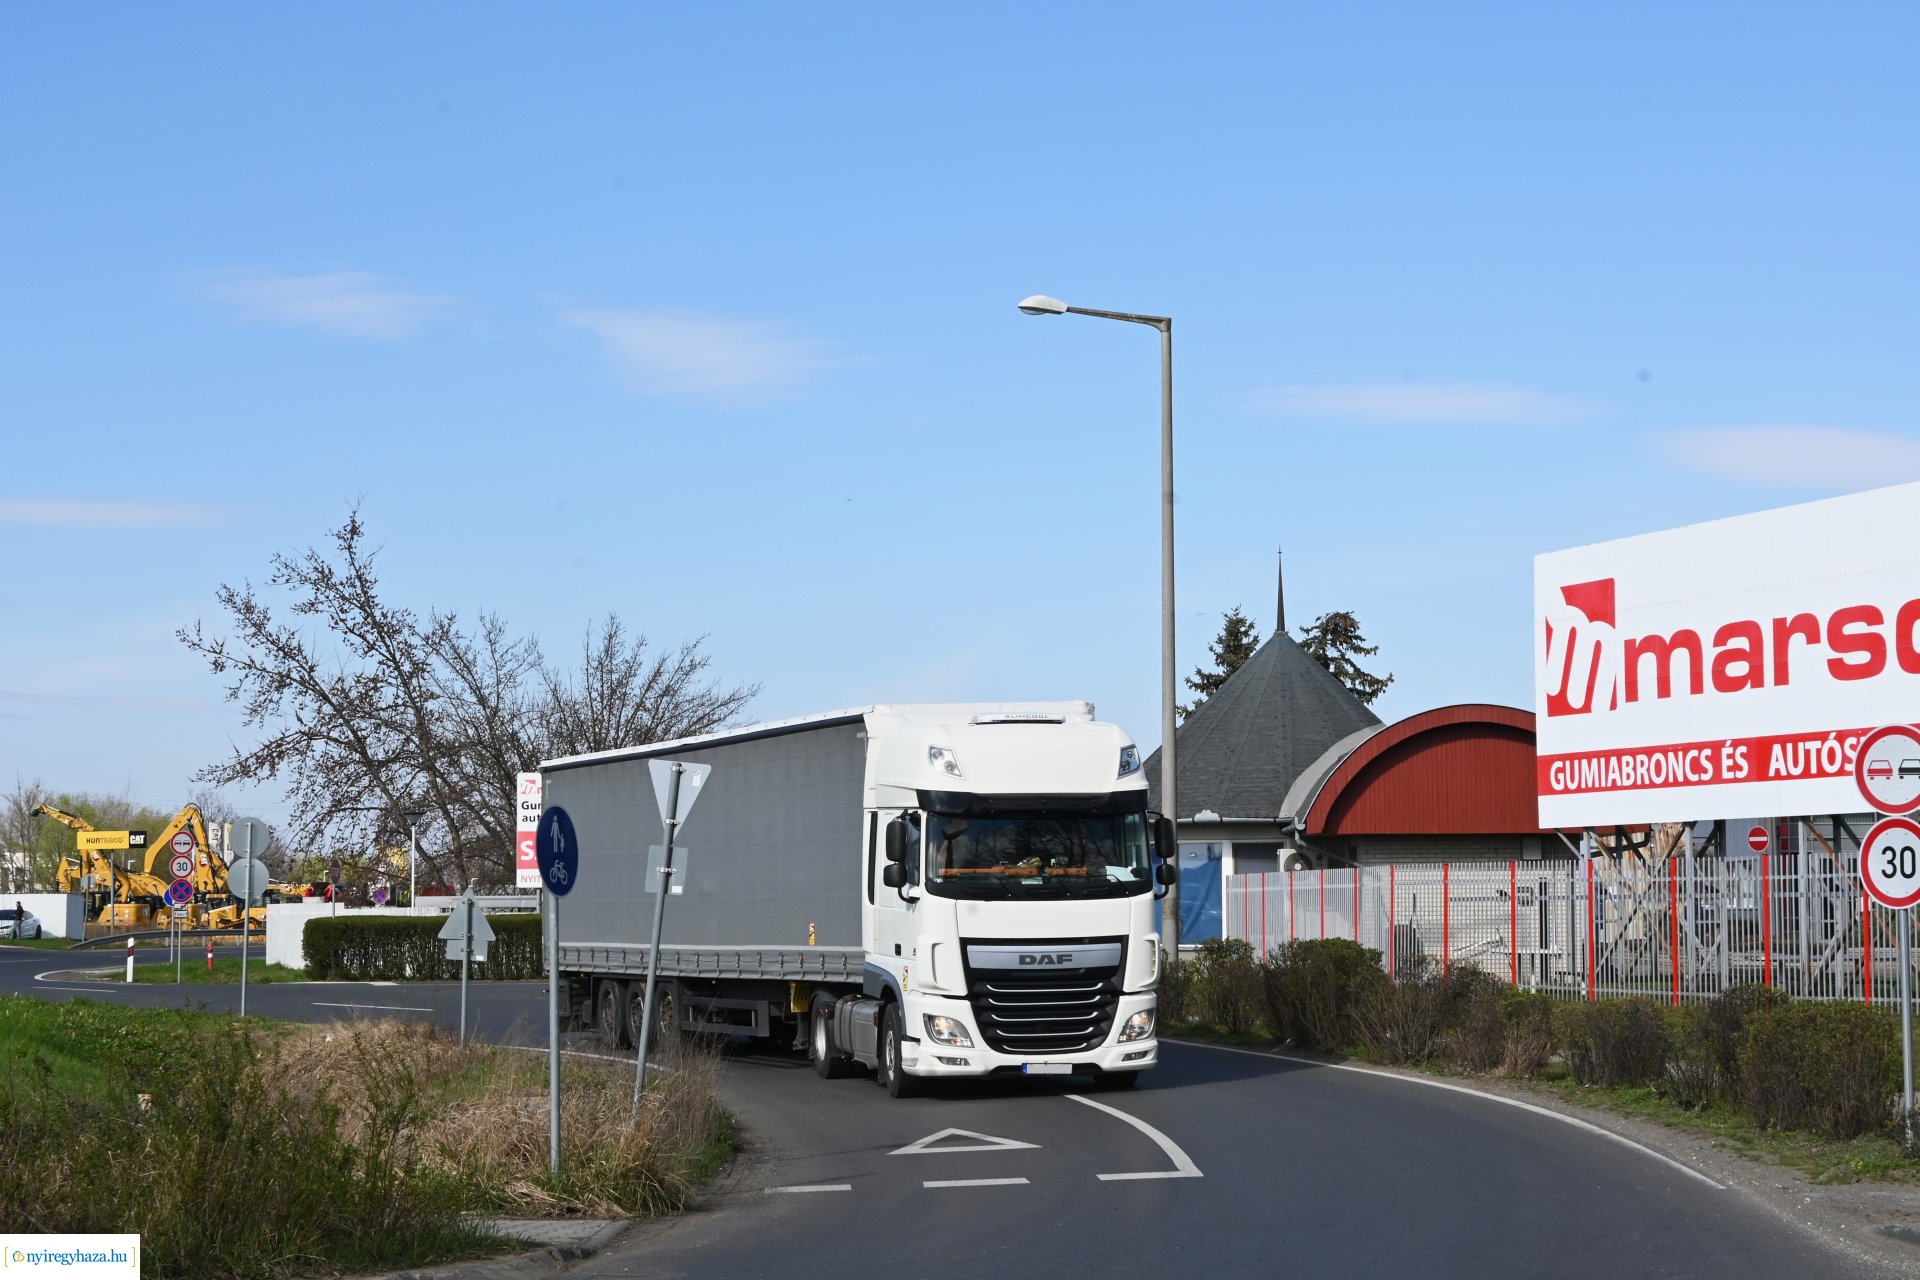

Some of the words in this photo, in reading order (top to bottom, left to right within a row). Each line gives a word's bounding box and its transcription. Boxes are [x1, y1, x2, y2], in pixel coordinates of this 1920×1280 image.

[1549, 748, 1713, 791] GUMIABRONCS
[1721, 740, 1749, 780] ÉS
[1768, 732, 1865, 777] AUTÓS
[129, 835, 145, 845] CAT
[520, 840, 537, 861] S
[176, 862, 188, 872] 30
[1881, 846, 1916, 879] 30
[1019, 954, 1073, 966] DAF
